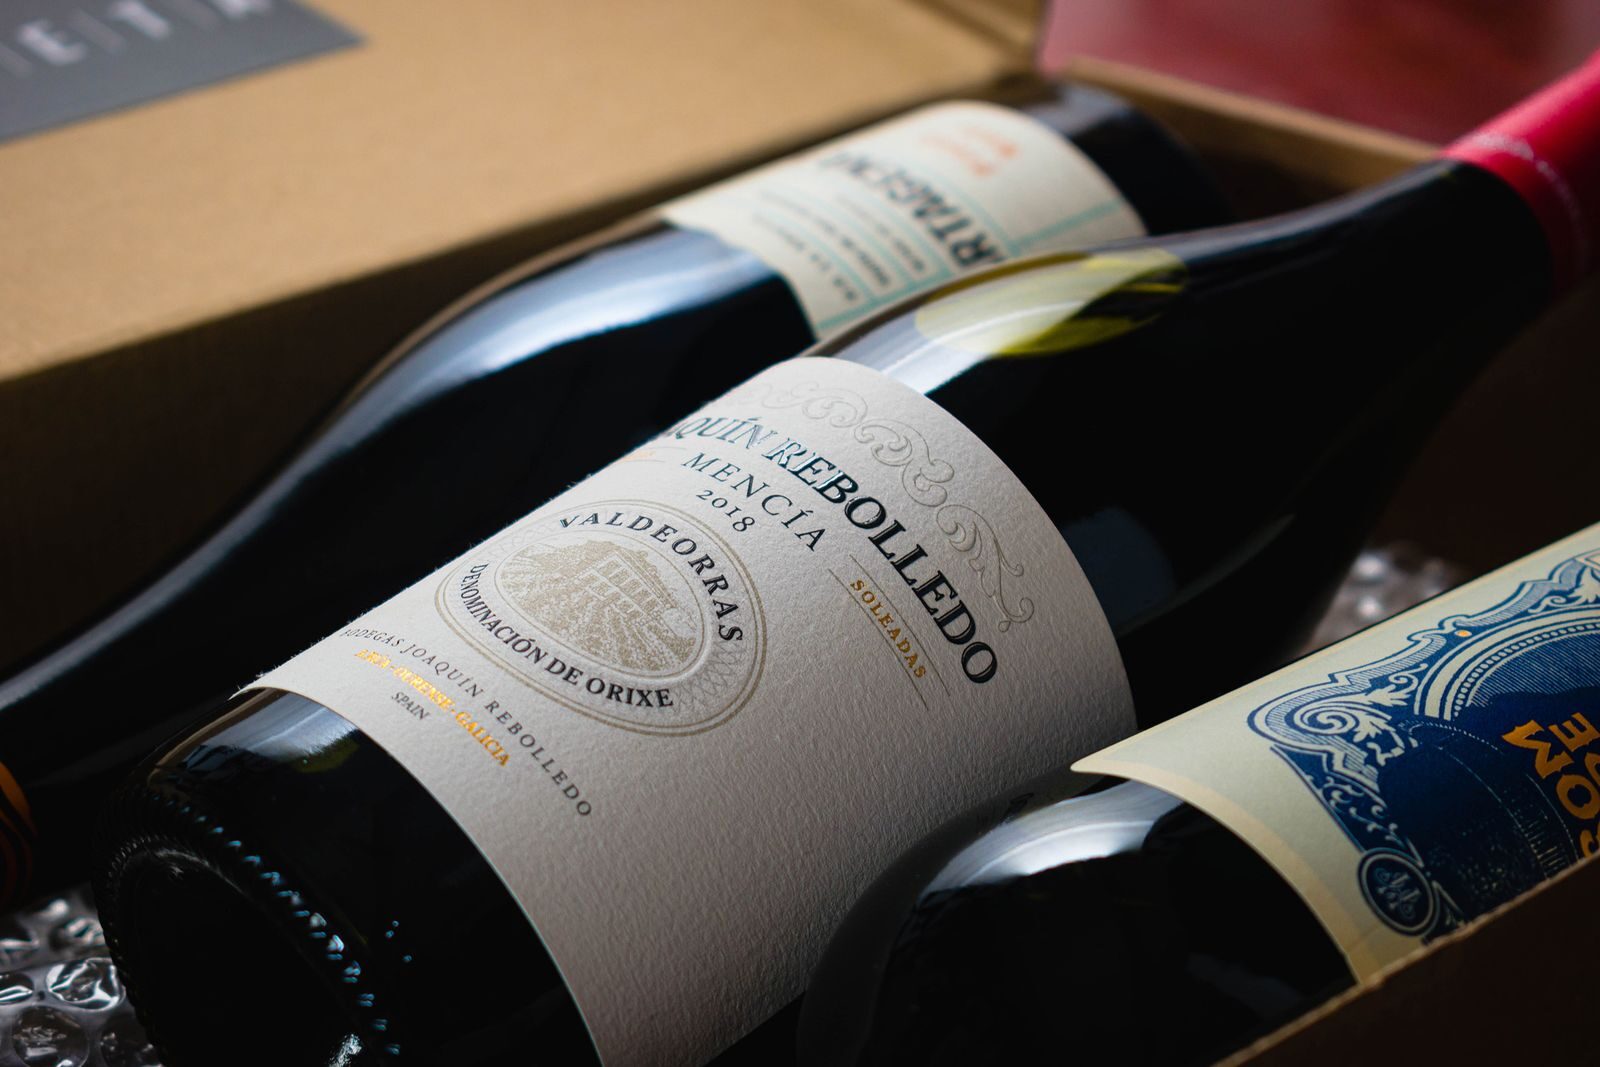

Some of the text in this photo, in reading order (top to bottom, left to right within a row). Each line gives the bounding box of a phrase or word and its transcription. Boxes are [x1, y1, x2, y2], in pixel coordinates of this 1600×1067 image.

[681, 452, 827, 552] MENCÍA
[696, 489, 756, 533] 2018
[559, 511, 744, 645] VALDEORRAS
[761, 438, 998, 684] REBOLLEDO
[460, 563, 674, 708] DENOMINACIÓN DE ORIXE
[849, 579, 927, 679] SOLEADAS
[391, 691, 430, 720] SPAIN
[484, 700, 592, 817] REBOLLEDO
